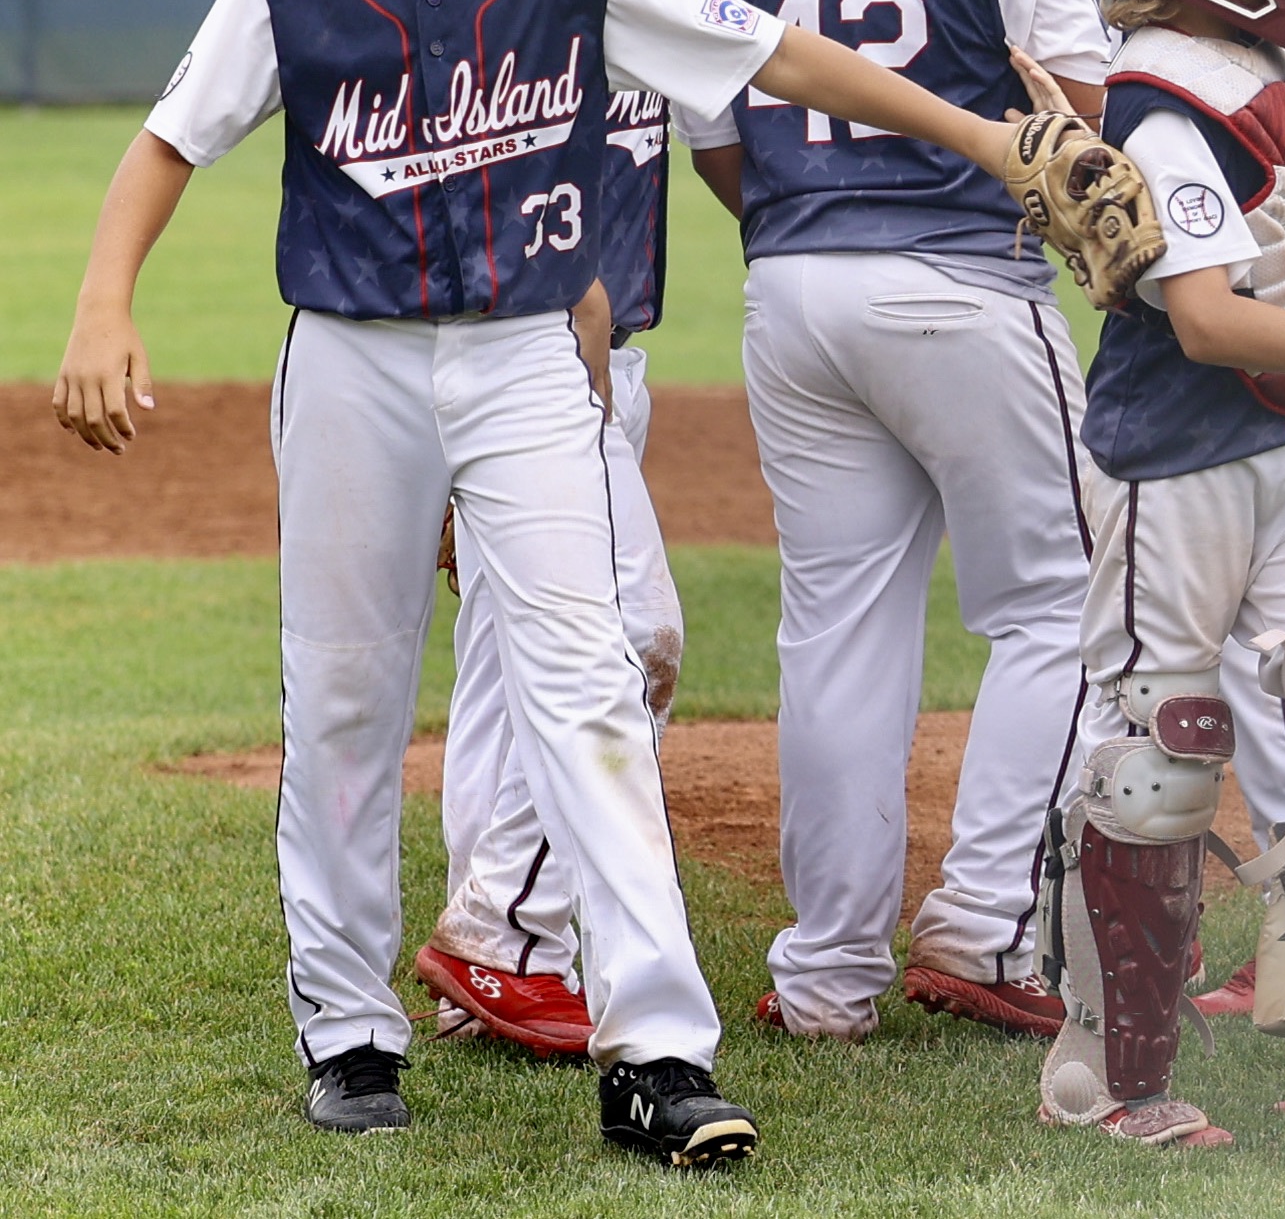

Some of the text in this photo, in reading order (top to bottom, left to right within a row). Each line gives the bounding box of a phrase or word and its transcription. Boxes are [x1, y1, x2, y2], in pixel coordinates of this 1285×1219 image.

[314, 36, 584, 159] Mid Island
[630, 1093, 654, 1130] N
